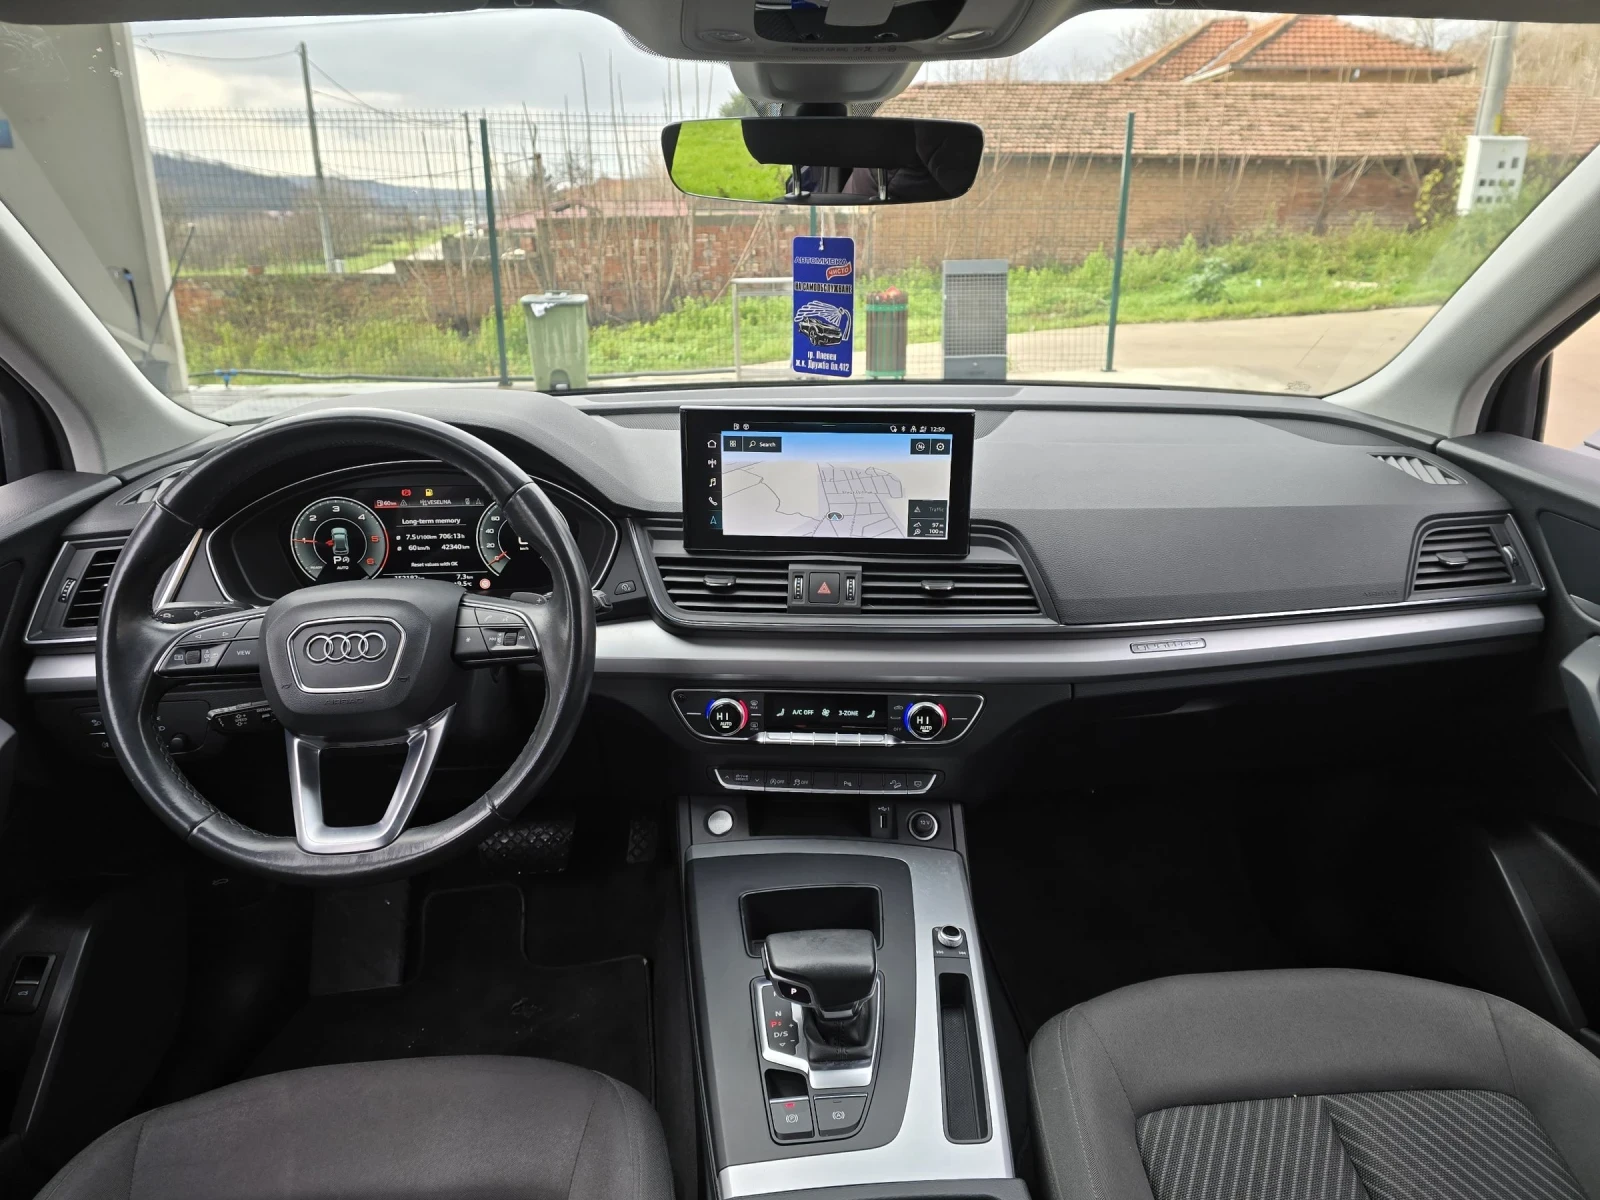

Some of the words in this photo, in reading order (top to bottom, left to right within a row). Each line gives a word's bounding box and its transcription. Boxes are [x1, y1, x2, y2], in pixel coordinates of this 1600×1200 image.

[794, 256, 848, 265] АВТОМИВКА
[829, 267, 849, 275] ЧИСТО
[816, 351, 837, 360] Плевен
[808, 360, 830, 370] Дружба
[333, 556, 341, 564] P
